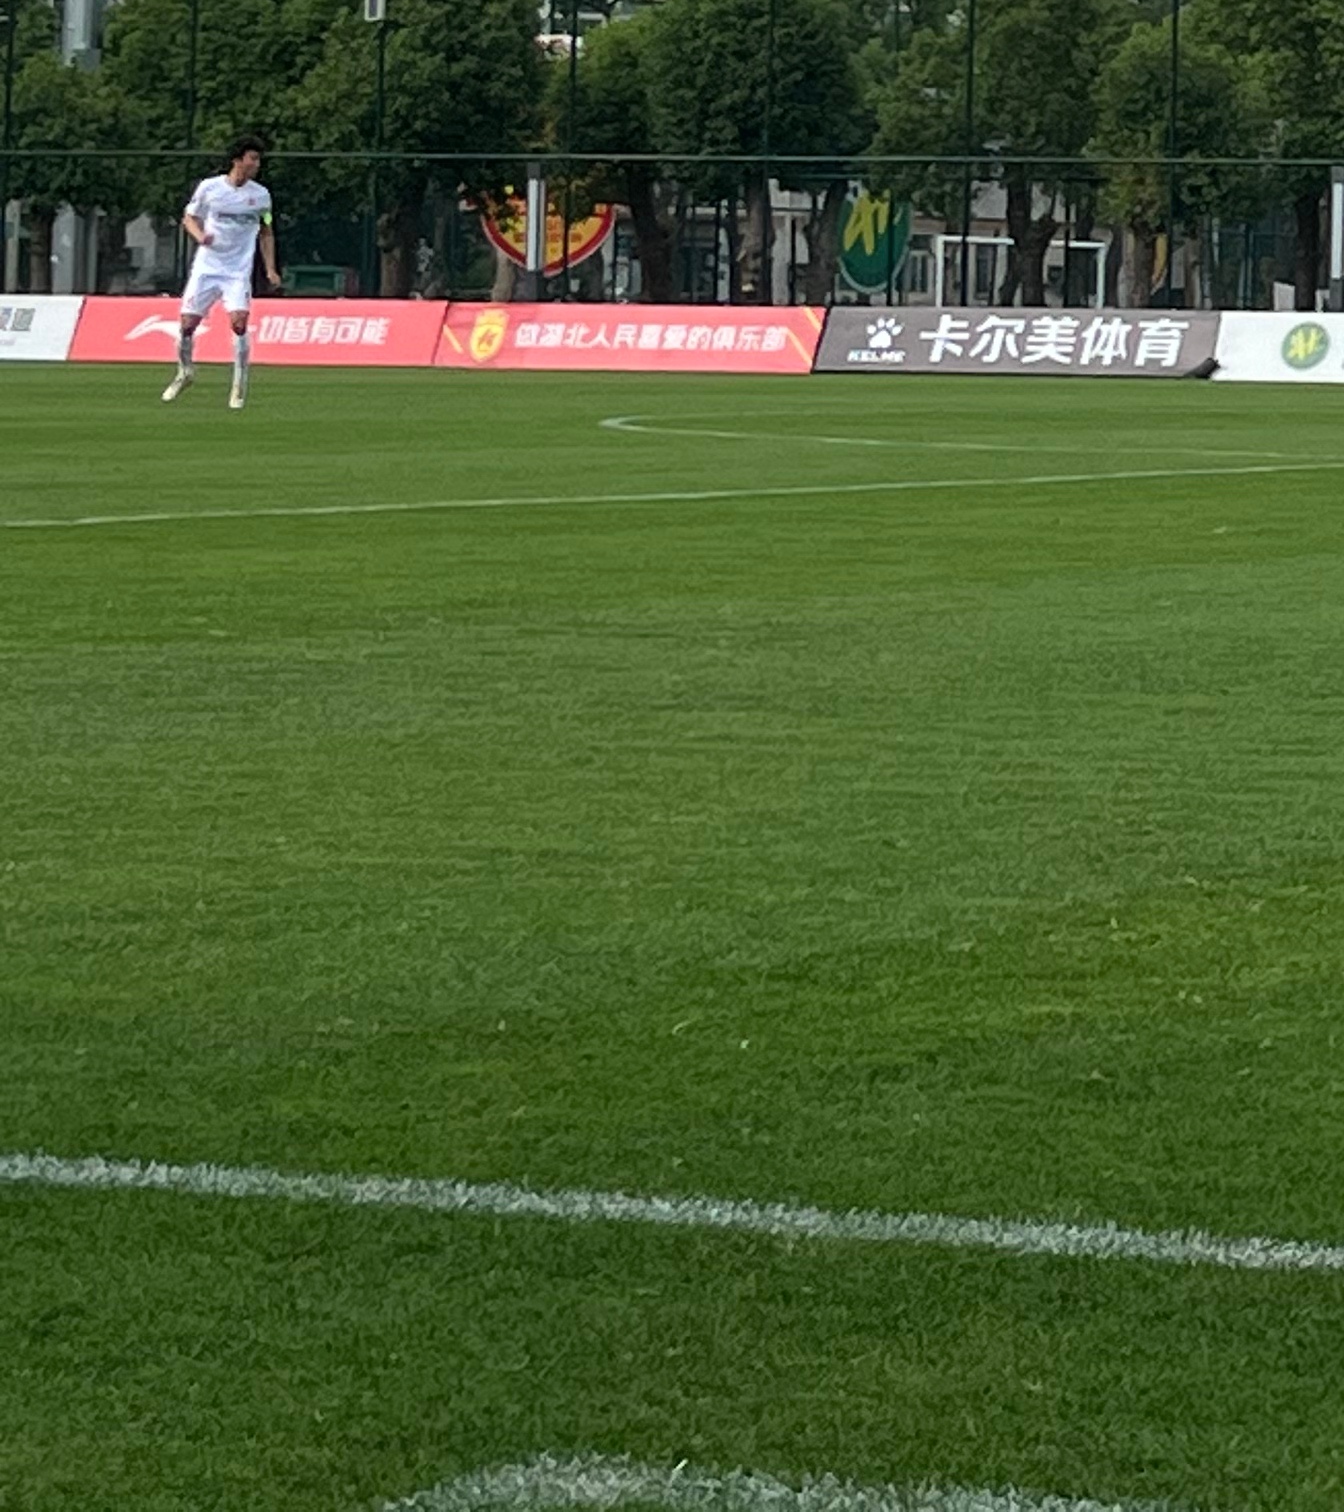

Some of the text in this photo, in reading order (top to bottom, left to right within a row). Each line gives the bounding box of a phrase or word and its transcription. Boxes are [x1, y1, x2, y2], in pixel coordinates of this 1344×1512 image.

[919, 314, 1190, 367] 卡尔美体育
